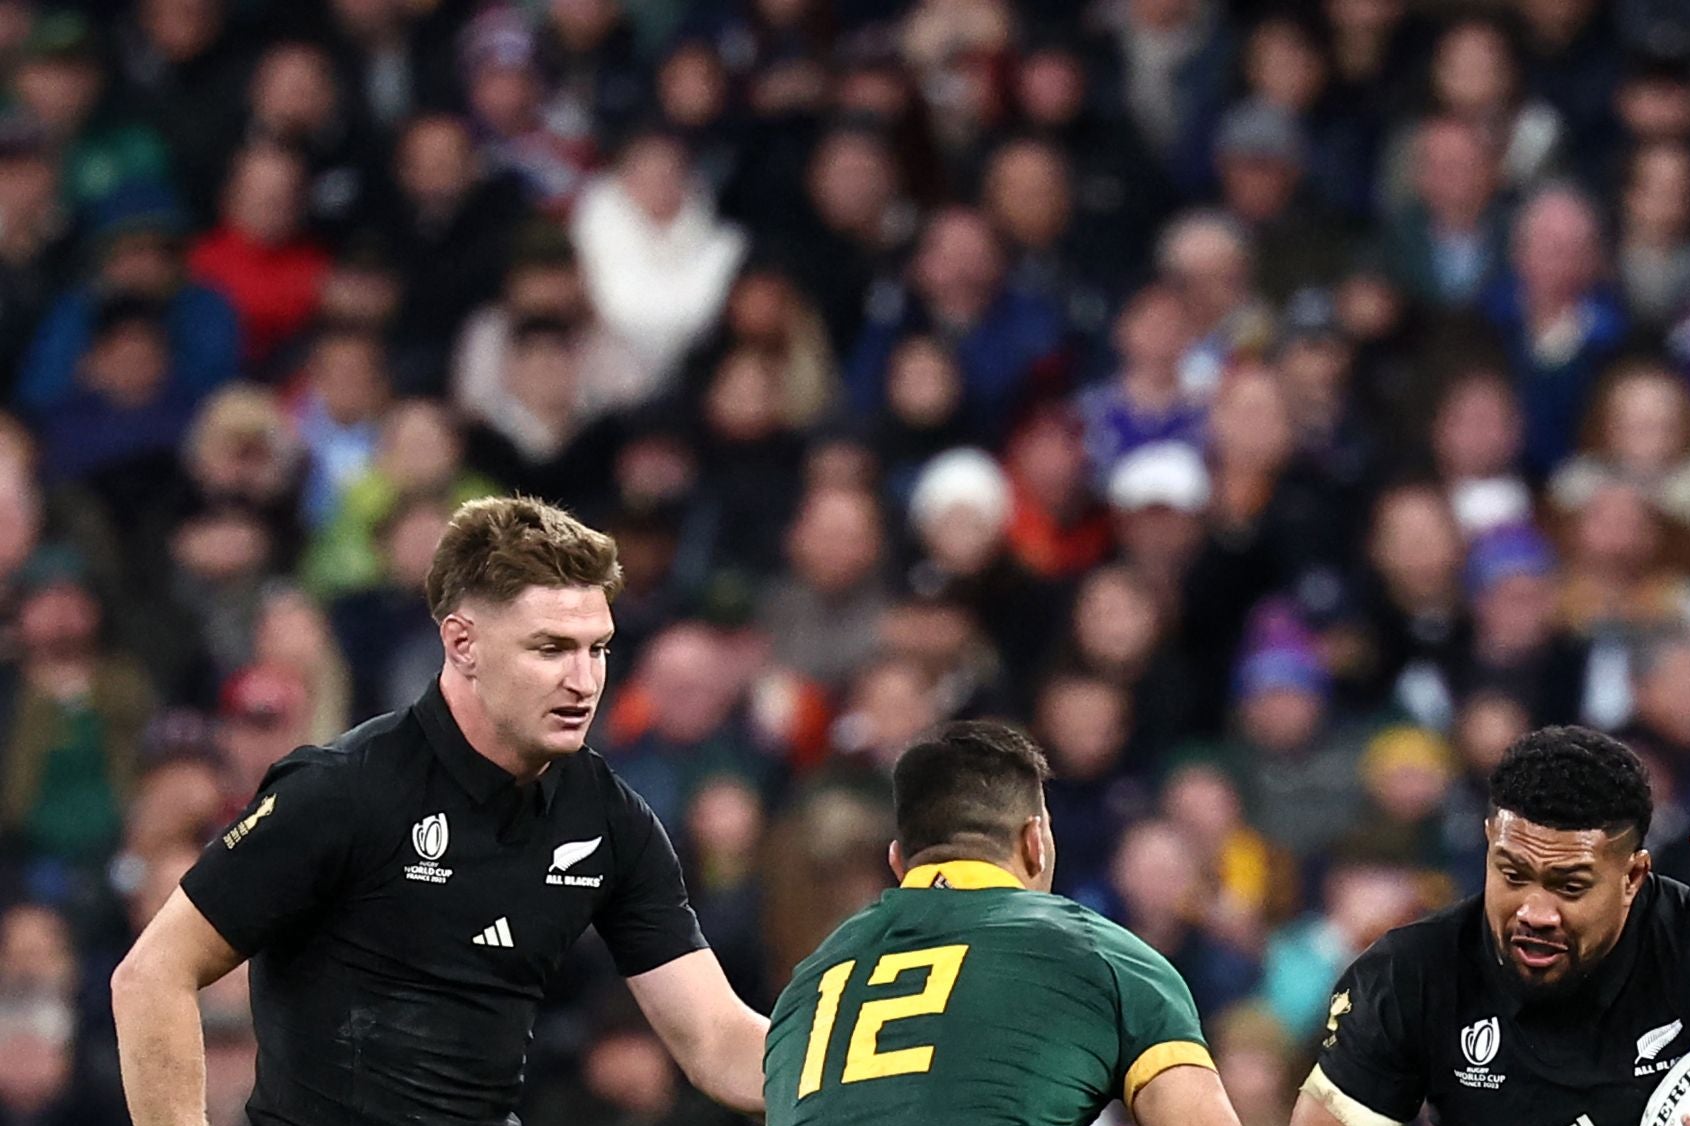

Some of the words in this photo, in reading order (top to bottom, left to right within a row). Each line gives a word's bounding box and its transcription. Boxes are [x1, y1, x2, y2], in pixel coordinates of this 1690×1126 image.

[404, 866, 435, 875] WORLD
[435, 868, 453, 877] CUP
[546, 874, 563, 885] ALL
[564, 875, 600, 887] BLACKS
[798, 944, 970, 1099] 12
[1454, 1069, 1486, 1081] WORLD
[1487, 1074, 1506, 1083] CUP
[1634, 1064, 1655, 1077] ALL
